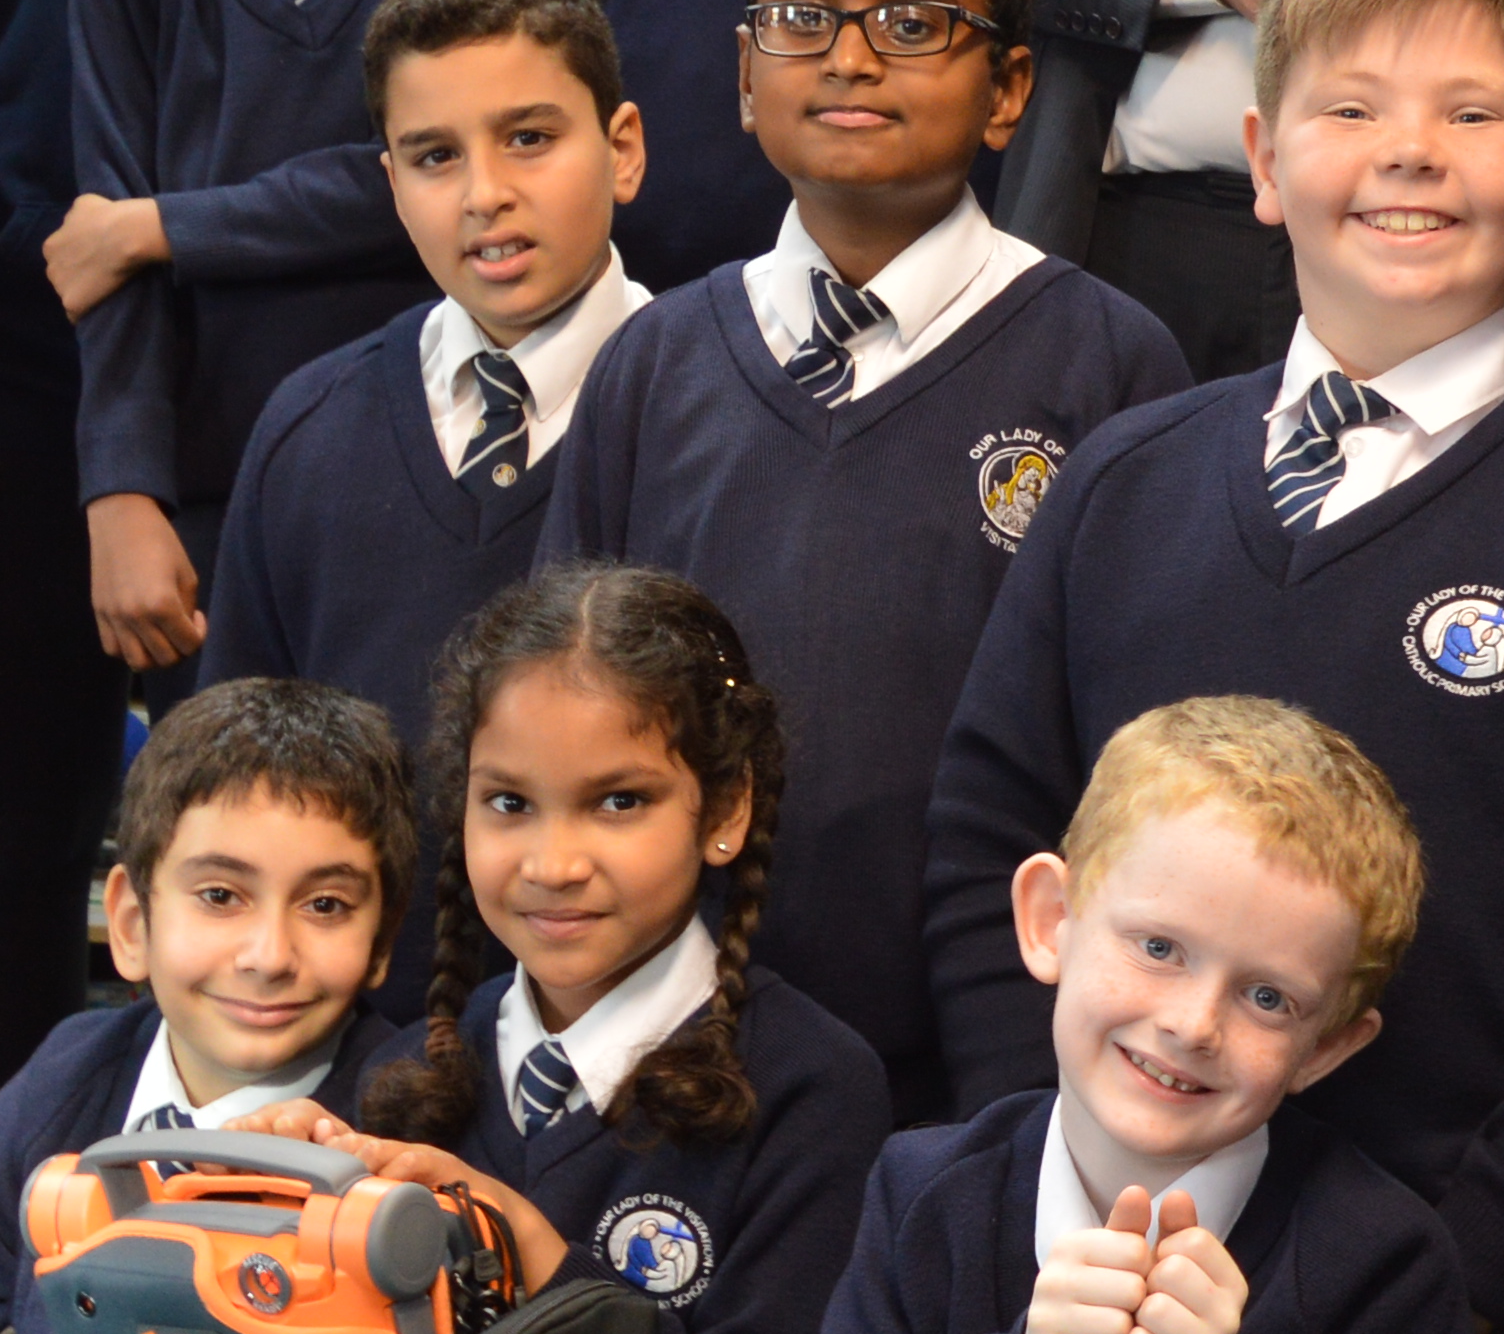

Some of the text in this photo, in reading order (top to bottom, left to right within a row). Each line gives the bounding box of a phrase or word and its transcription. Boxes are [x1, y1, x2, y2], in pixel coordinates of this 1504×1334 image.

[969, 427, 1066, 460] OUR LADY OF
[980, 520, 1018, 554] VISITA
[1406, 601, 1429, 627] OUR
[1424, 586, 1456, 607] LADY
[1459, 584, 1479, 595] OF
[1402, 635, 1440, 686] CATHOLIC
[1436, 678, 1492, 698] PRIMARY
[596, 1193, 714, 1268] OUR LADY OF THE VISITATION
